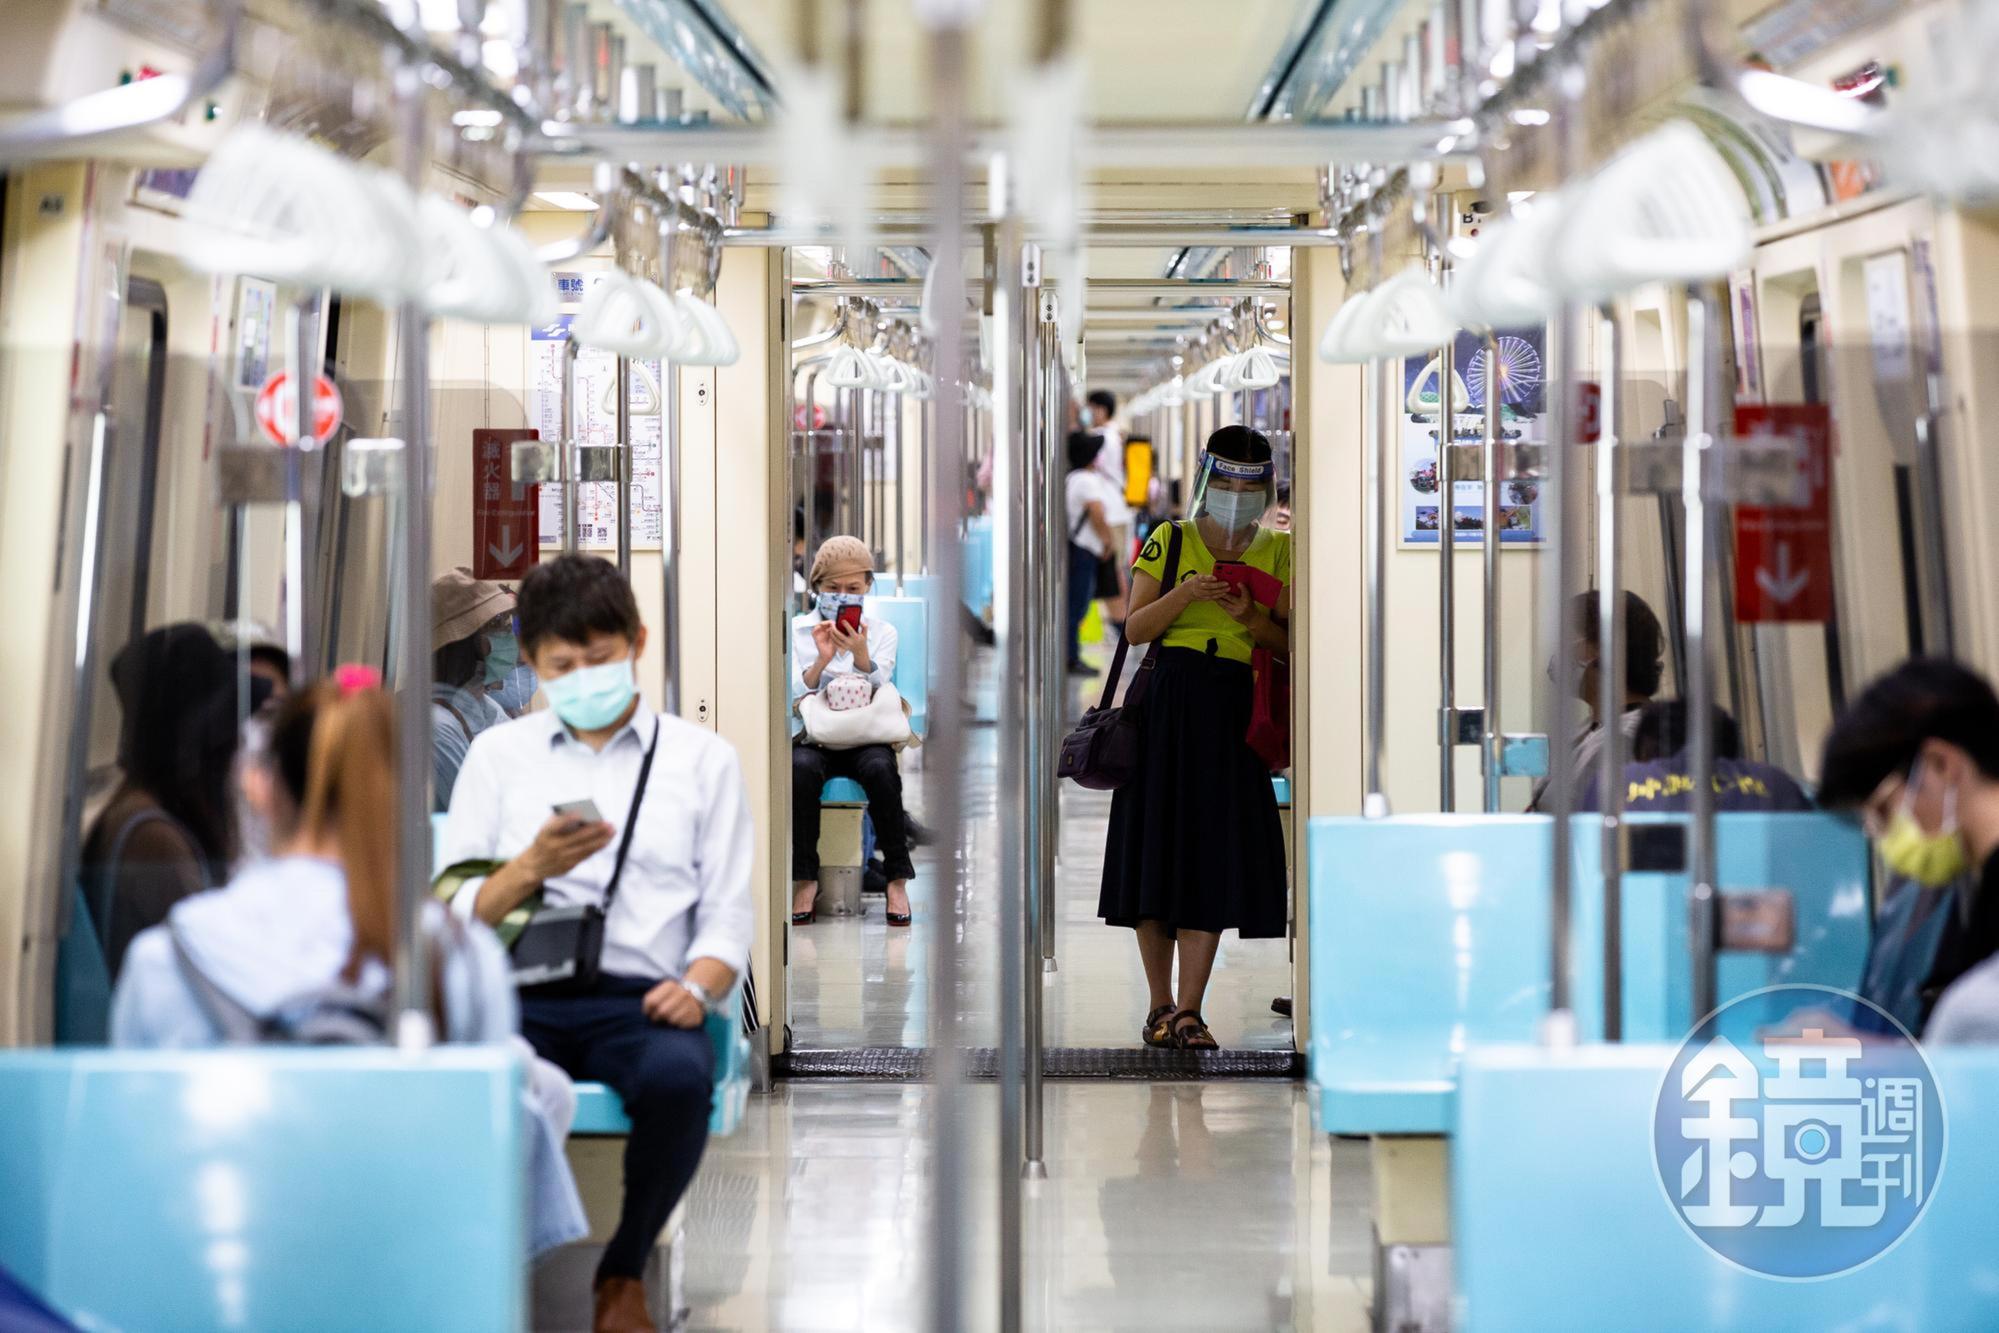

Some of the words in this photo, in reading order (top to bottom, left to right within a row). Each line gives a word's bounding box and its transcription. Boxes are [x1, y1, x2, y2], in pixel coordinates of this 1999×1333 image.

[558, 279, 583, 291] 車號
[1219, 462, 1235, 471] Face
[1239, 465, 1262, 475] Shield
